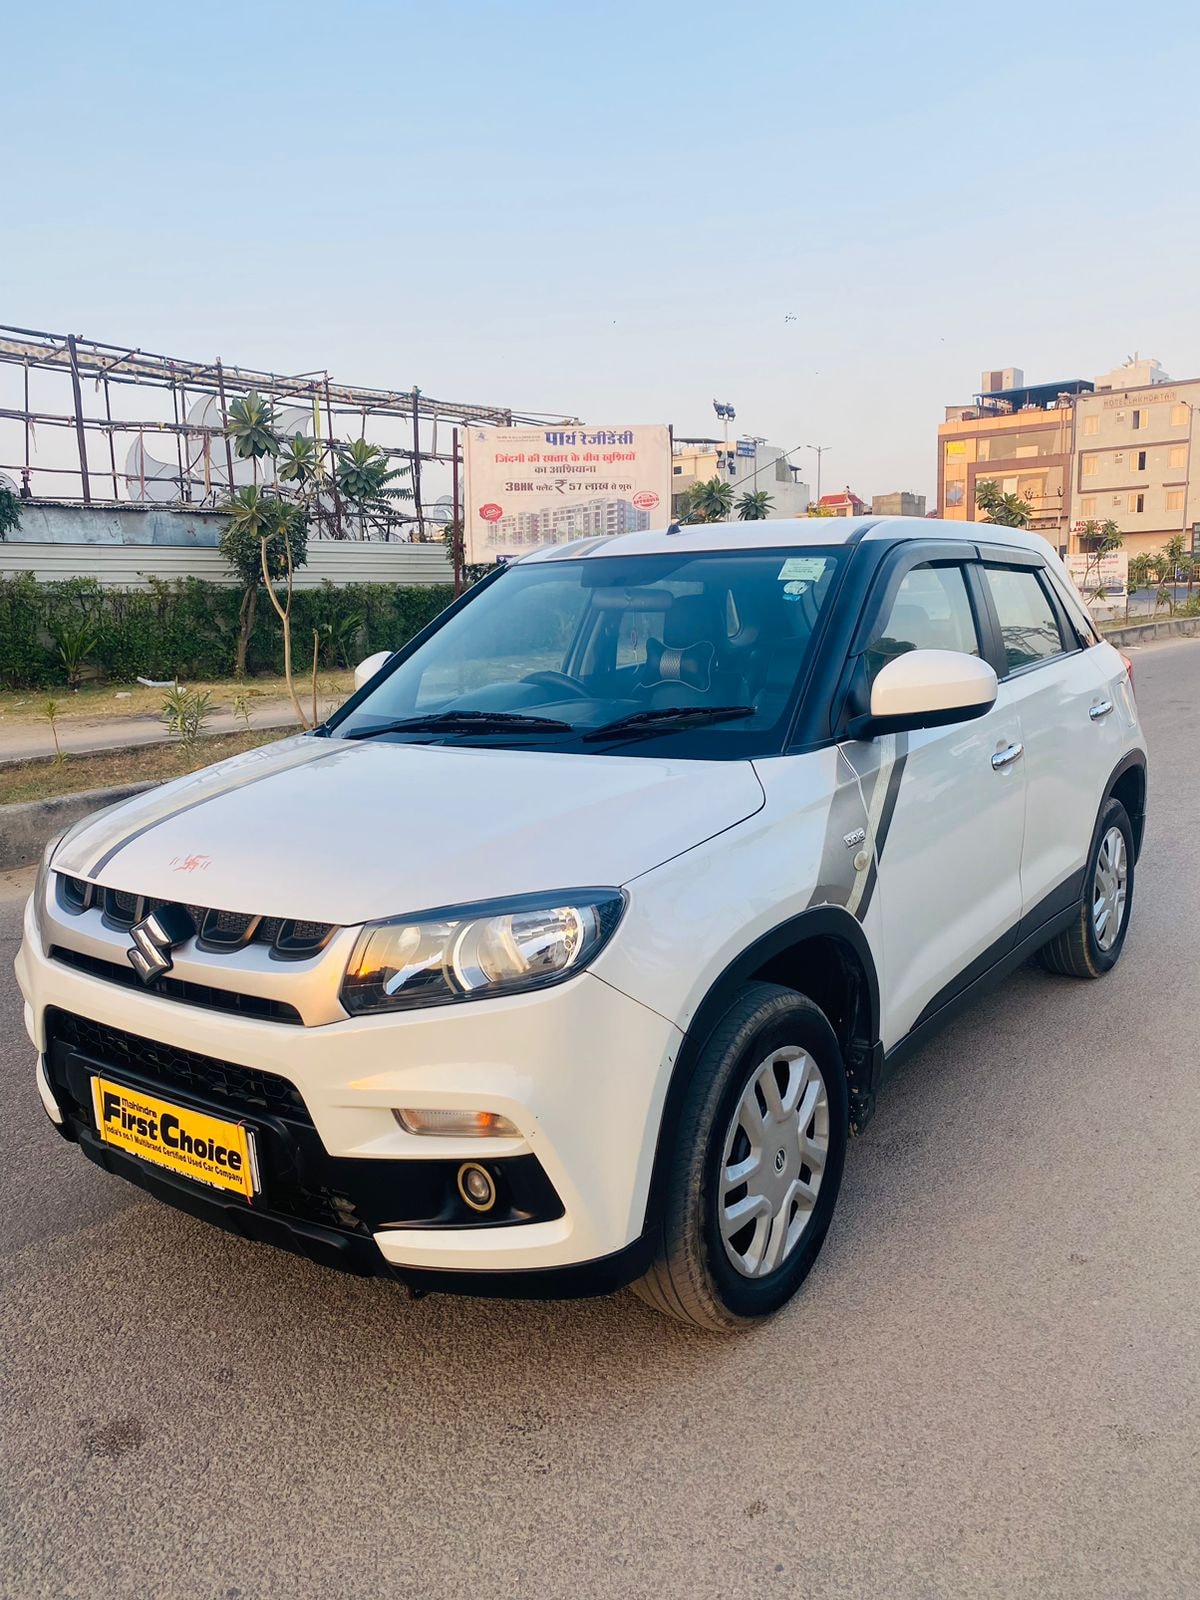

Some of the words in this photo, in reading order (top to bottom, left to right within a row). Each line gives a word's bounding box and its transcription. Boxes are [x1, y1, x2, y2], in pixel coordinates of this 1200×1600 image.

[544, 431, 577, 446] पार्थ
[528, 453, 540, 462] की
[571, 452, 580, 462] के
[583, 452, 599, 462] बीच
[505, 482, 533, 491] 3BHK
[569, 482, 582, 490] 57
[585, 482, 609, 491] लाख
[134, 1135, 162, 1153] Multibrand
[163, 1146, 186, 1162] Certified
[187, 1155, 202, 1169] Used
[203, 1161, 214, 1173] Car
[215, 1166, 243, 1184] Company
